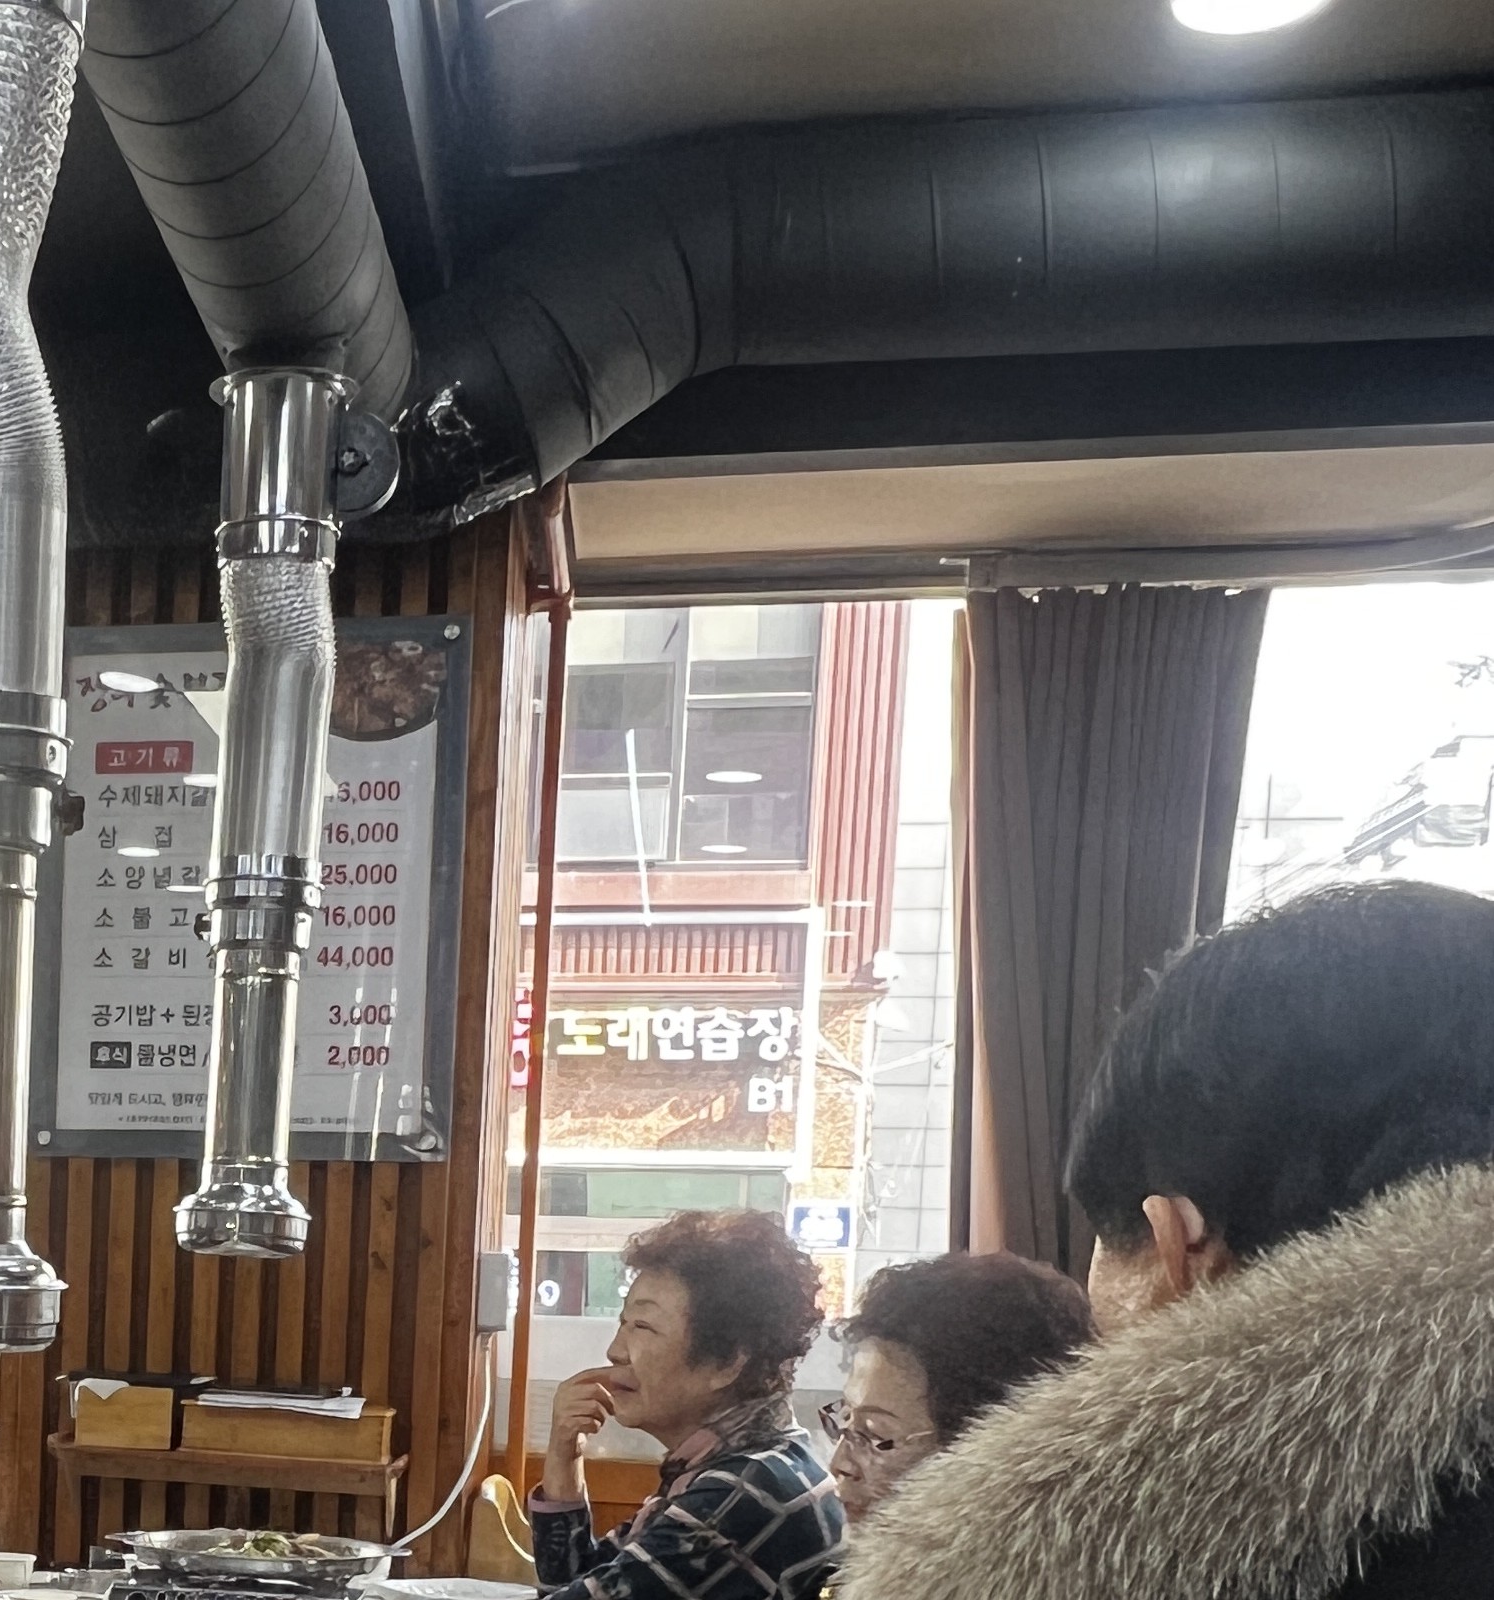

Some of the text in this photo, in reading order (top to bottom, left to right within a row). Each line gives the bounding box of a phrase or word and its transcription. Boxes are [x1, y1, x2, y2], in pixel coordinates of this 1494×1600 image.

[97, 780, 401, 808] 수제돼지갈 6,000
[323, 822, 399, 846] 16,000
[321, 863, 397, 886] 25,000
[321, 904, 396, 929] 16,000
[316, 945, 394, 970] 44,000
[328, 1004, 392, 1027] 3,000
[327, 1046, 390, 1069] 2,000
